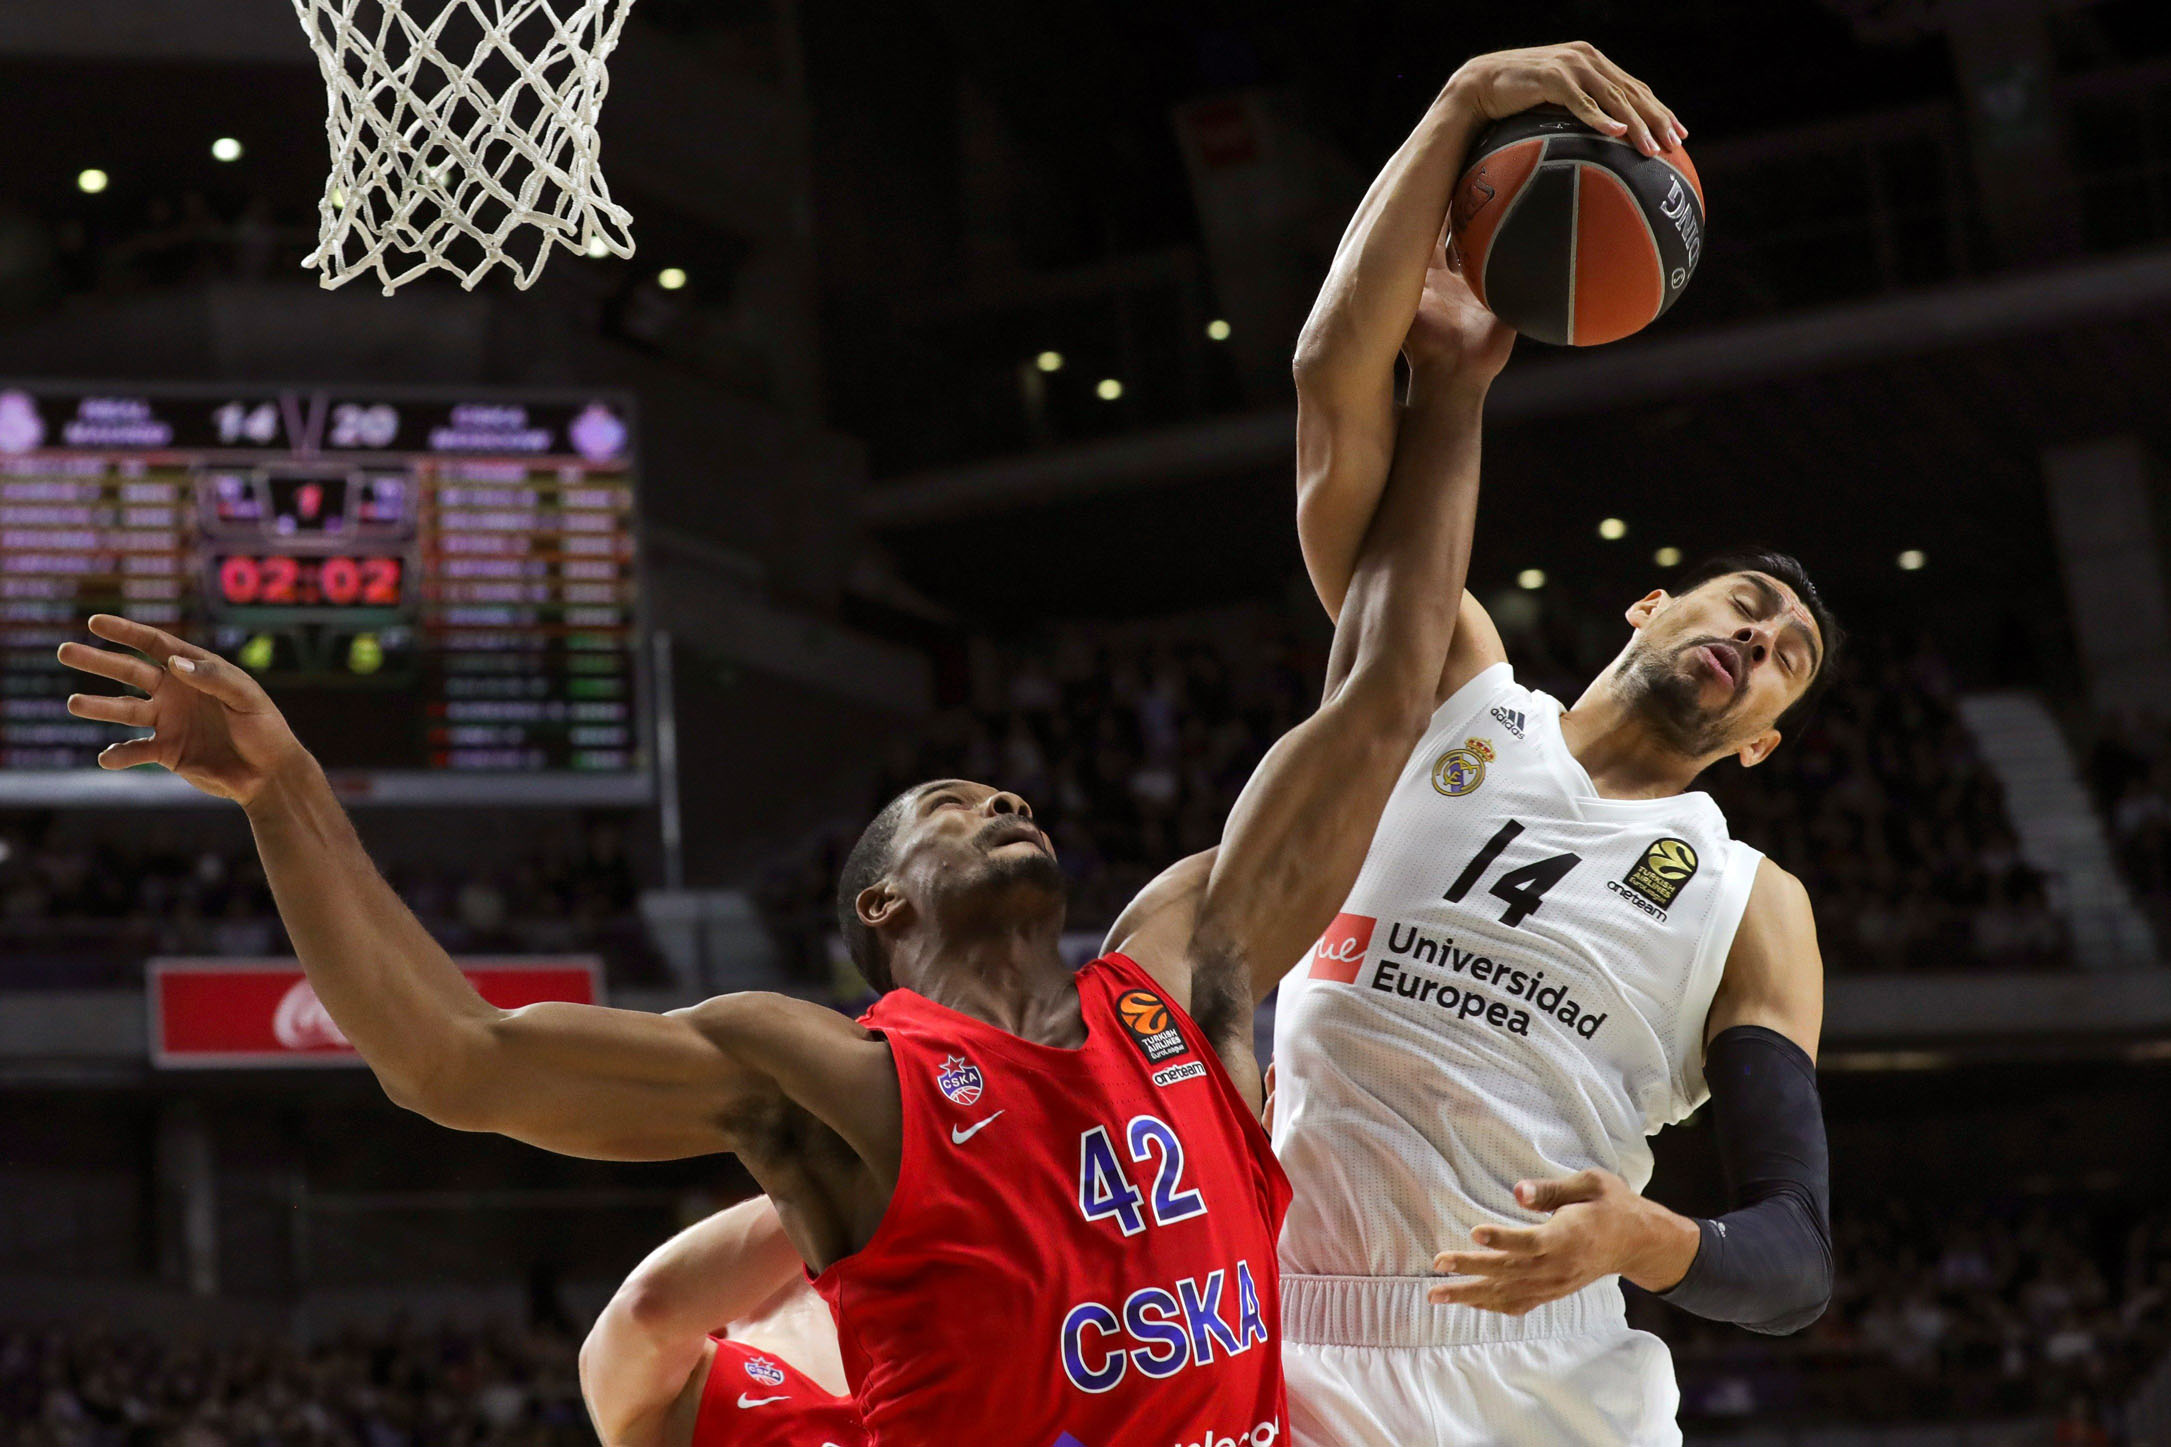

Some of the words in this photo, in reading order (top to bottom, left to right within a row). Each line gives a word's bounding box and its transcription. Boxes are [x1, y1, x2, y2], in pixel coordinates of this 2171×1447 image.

[330, 402, 399, 446] 20
[220, 554, 400, 604] 02:02
[1490, 707, 1525, 740] adidas
[1442, 818, 1583, 928] 14
[1607, 880, 1667, 922] oneteam
[1371, 959, 1531, 1036] Europea
[1387, 922, 1607, 1040] Universidad
[1141, 1028, 1178, 1046] TURKISH
[1147, 1036, 1182, 1053] AIRLINES
[942, 1072, 978, 1089] CSKA
[1154, 1062, 1205, 1085] oneteam
[1079, 1114, 1208, 1237] 42
[1060, 1260, 1268, 1393] CSKA
